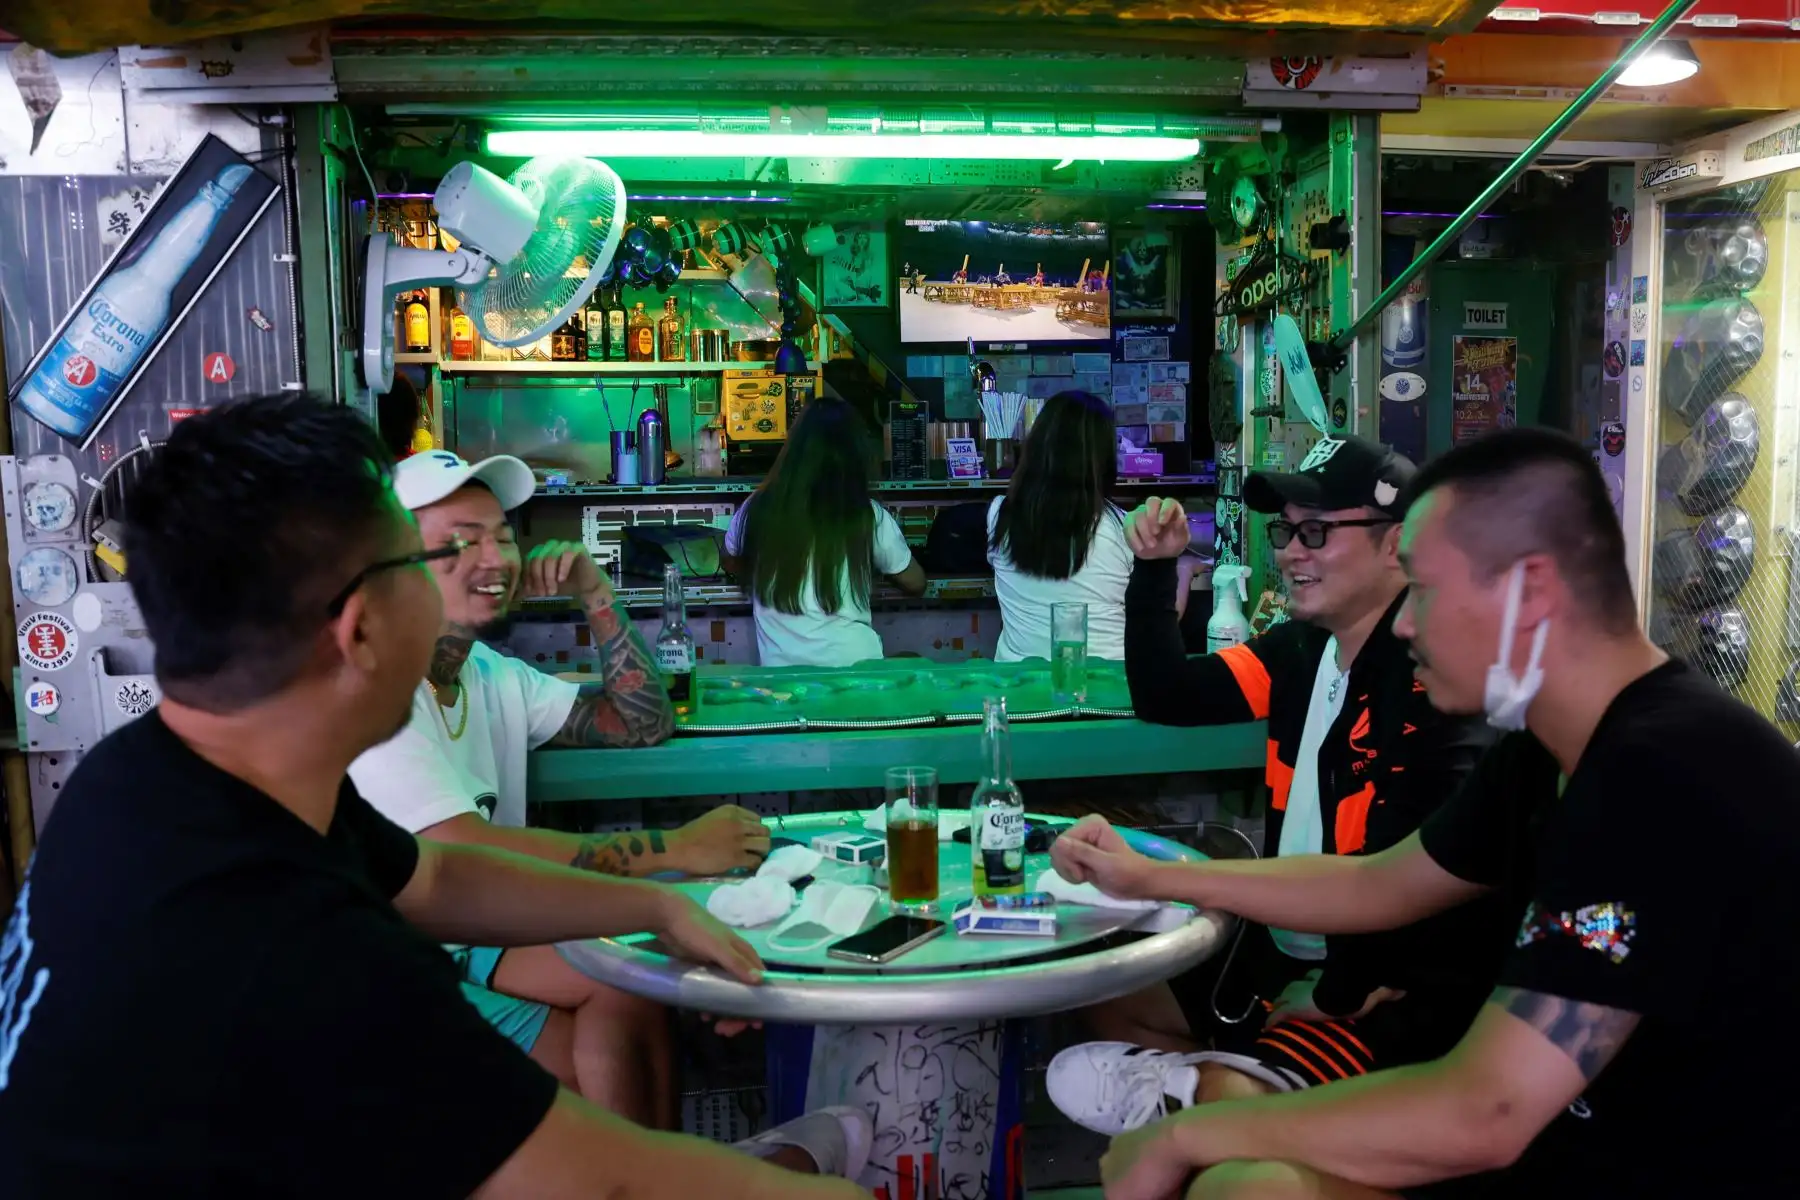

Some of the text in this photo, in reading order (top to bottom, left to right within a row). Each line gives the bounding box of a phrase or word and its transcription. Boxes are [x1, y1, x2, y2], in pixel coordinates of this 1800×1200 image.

[89, 299, 145, 347] Corona
[1467, 308, 1505, 323] TOILET
[92, 322, 125, 353] Extra
[1465, 374, 1480, 391] 14
[953, 445, 972, 453] VISA
[37, 613, 74, 634] Festival
[25, 650, 73, 669] since 1992
